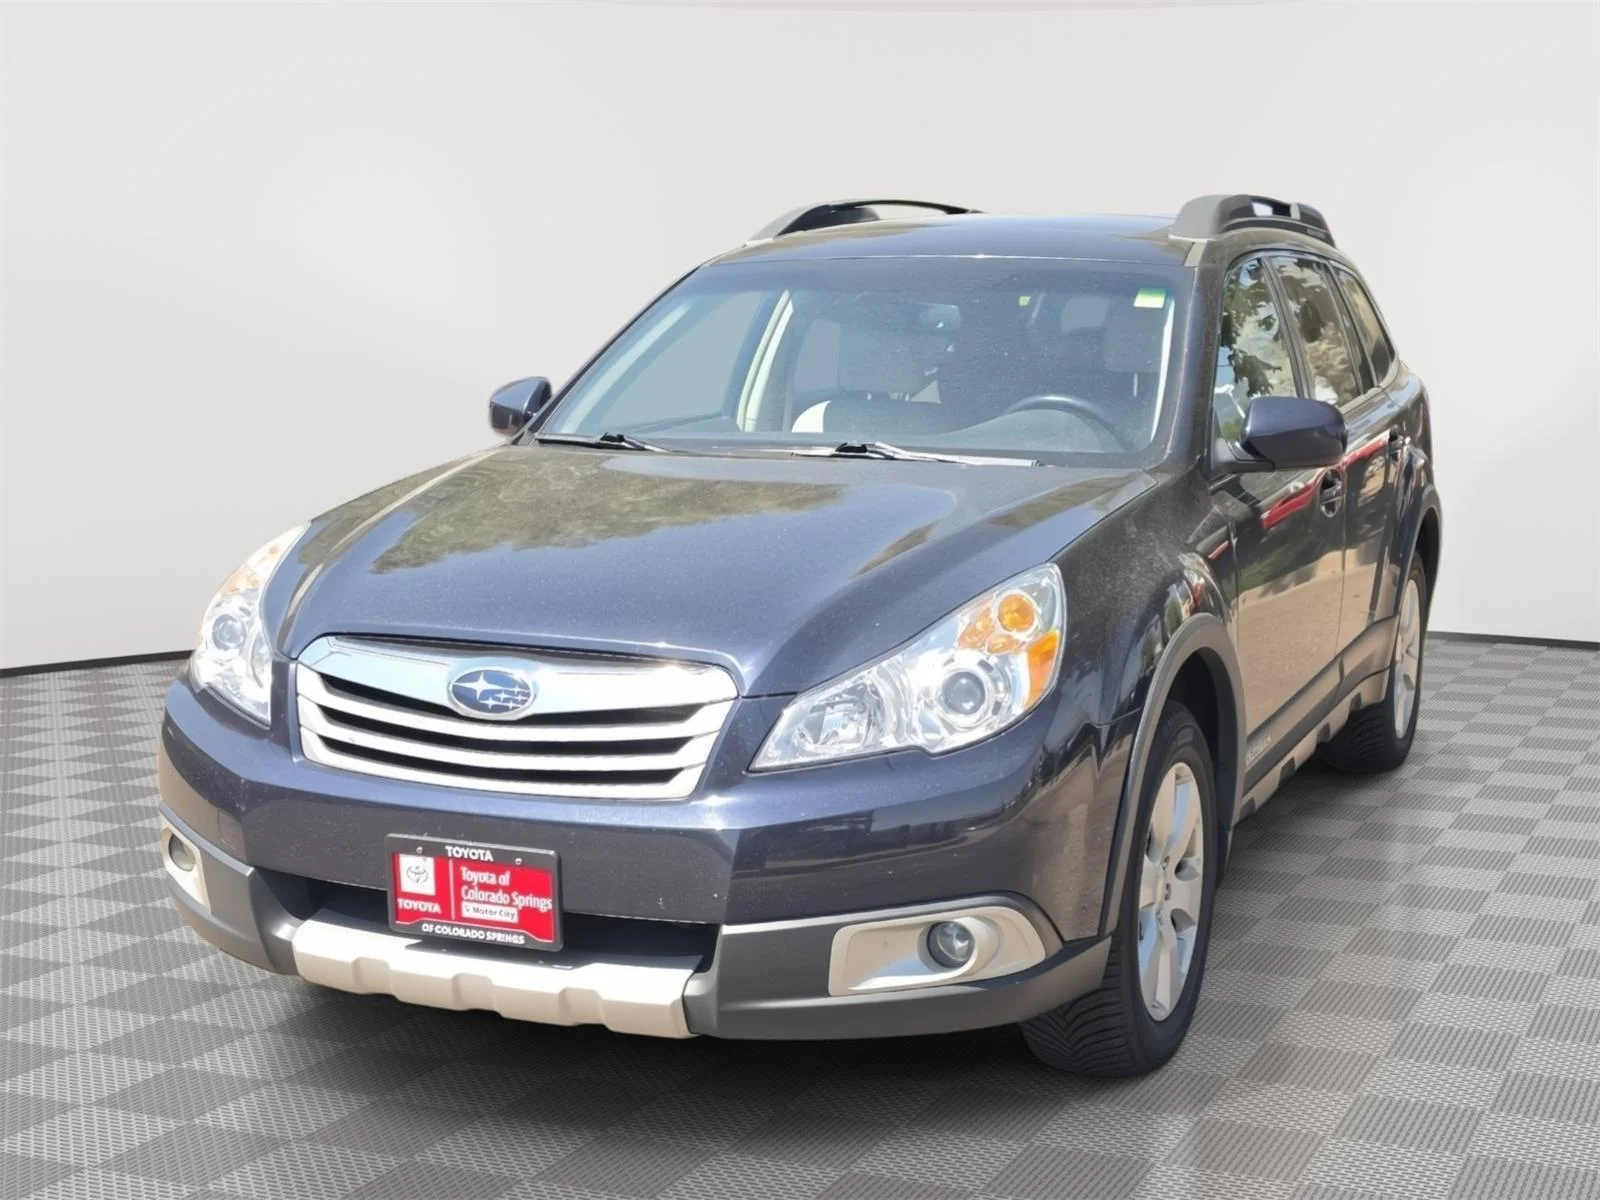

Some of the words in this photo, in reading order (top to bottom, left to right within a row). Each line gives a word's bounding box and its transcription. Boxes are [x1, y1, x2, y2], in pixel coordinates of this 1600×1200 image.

[445, 845, 494, 862] TOYOTA
[460, 866, 497, 886] Toyota
[499, 870, 511, 886] of
[397, 897, 442, 914] TOYOTA
[461, 885, 510, 905] Colorado
[512, 890, 553, 912] Springs
[472, 906, 497, 916] Motor
[499, 909, 516, 920] City
[421, 922, 434, 933] OF
[434, 924, 485, 940] COLORADO
[486, 930, 526, 945] SPRINGS
